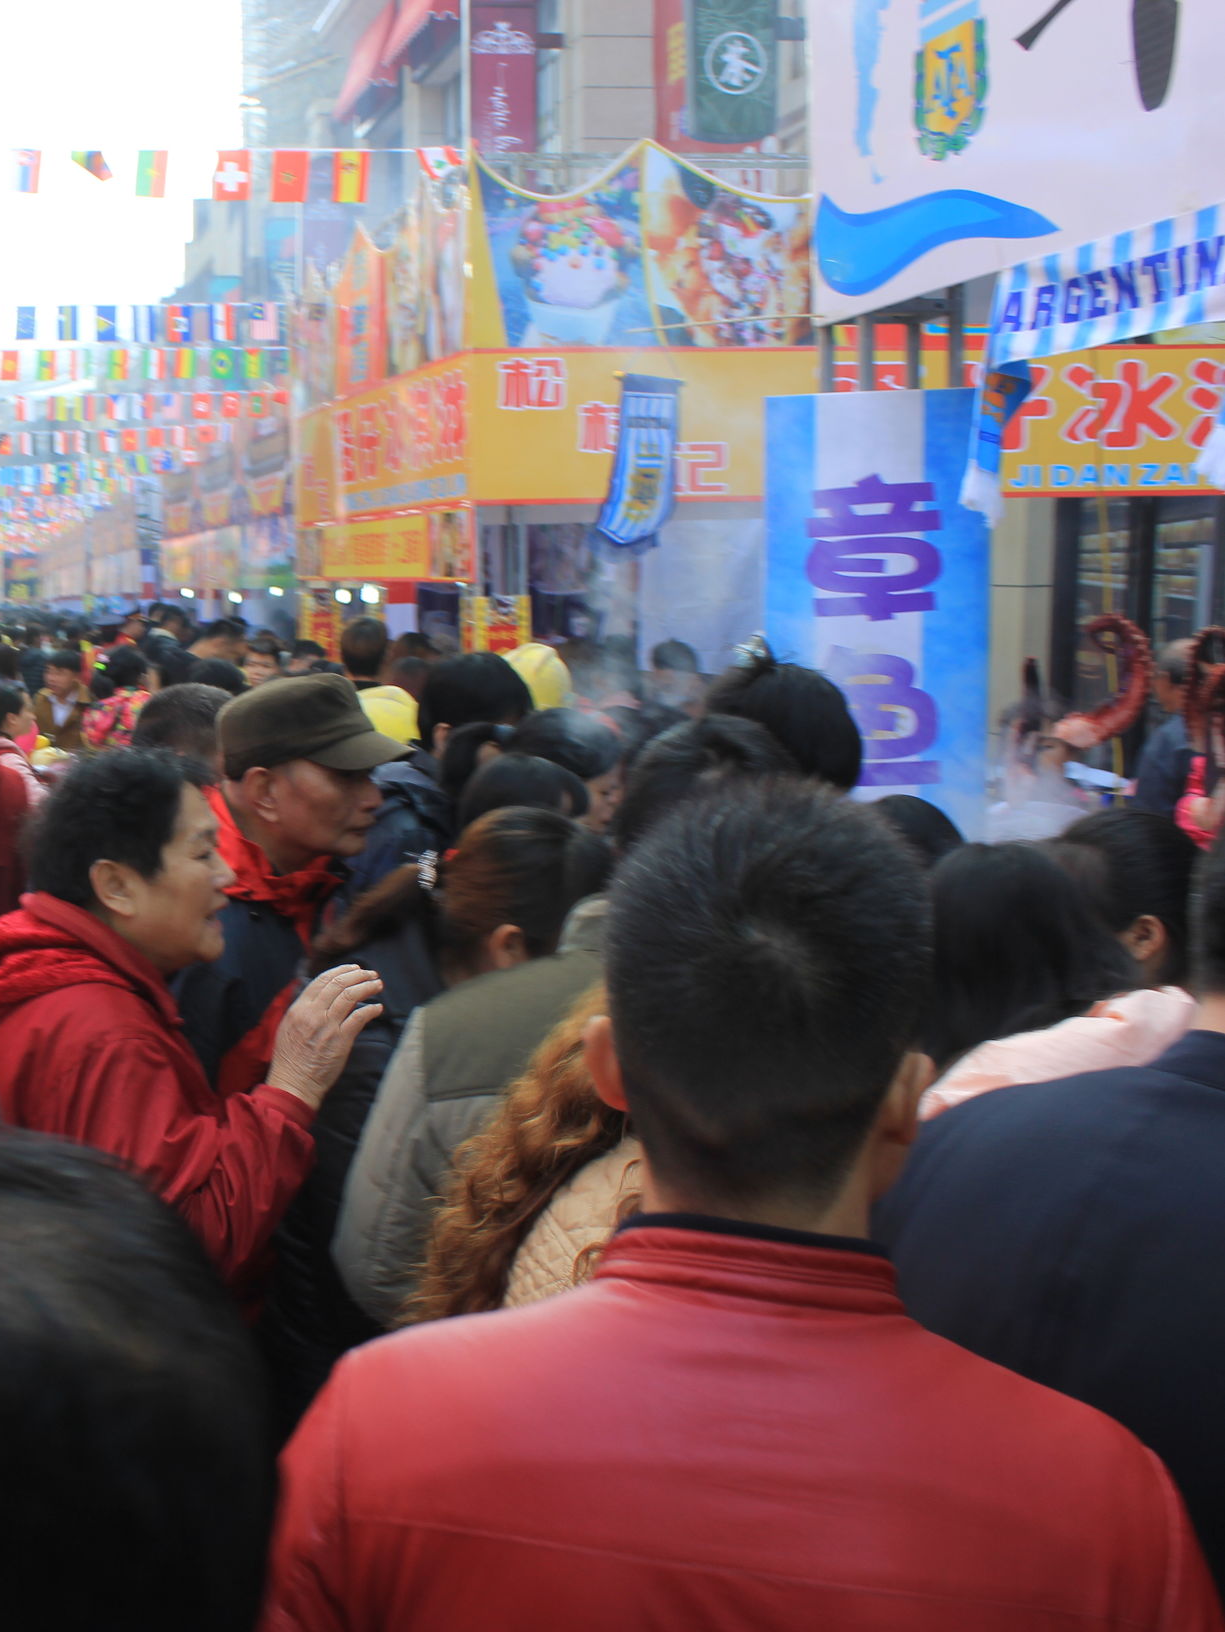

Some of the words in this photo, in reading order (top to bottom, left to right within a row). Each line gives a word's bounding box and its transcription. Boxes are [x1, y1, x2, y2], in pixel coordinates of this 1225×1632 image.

[996, 235, 1225, 333] ARGENTIN
[1009, 464, 1042, 488] JI
[1050, 464, 1131, 487] DAN
[805, 472, 944, 787] 章鱼
